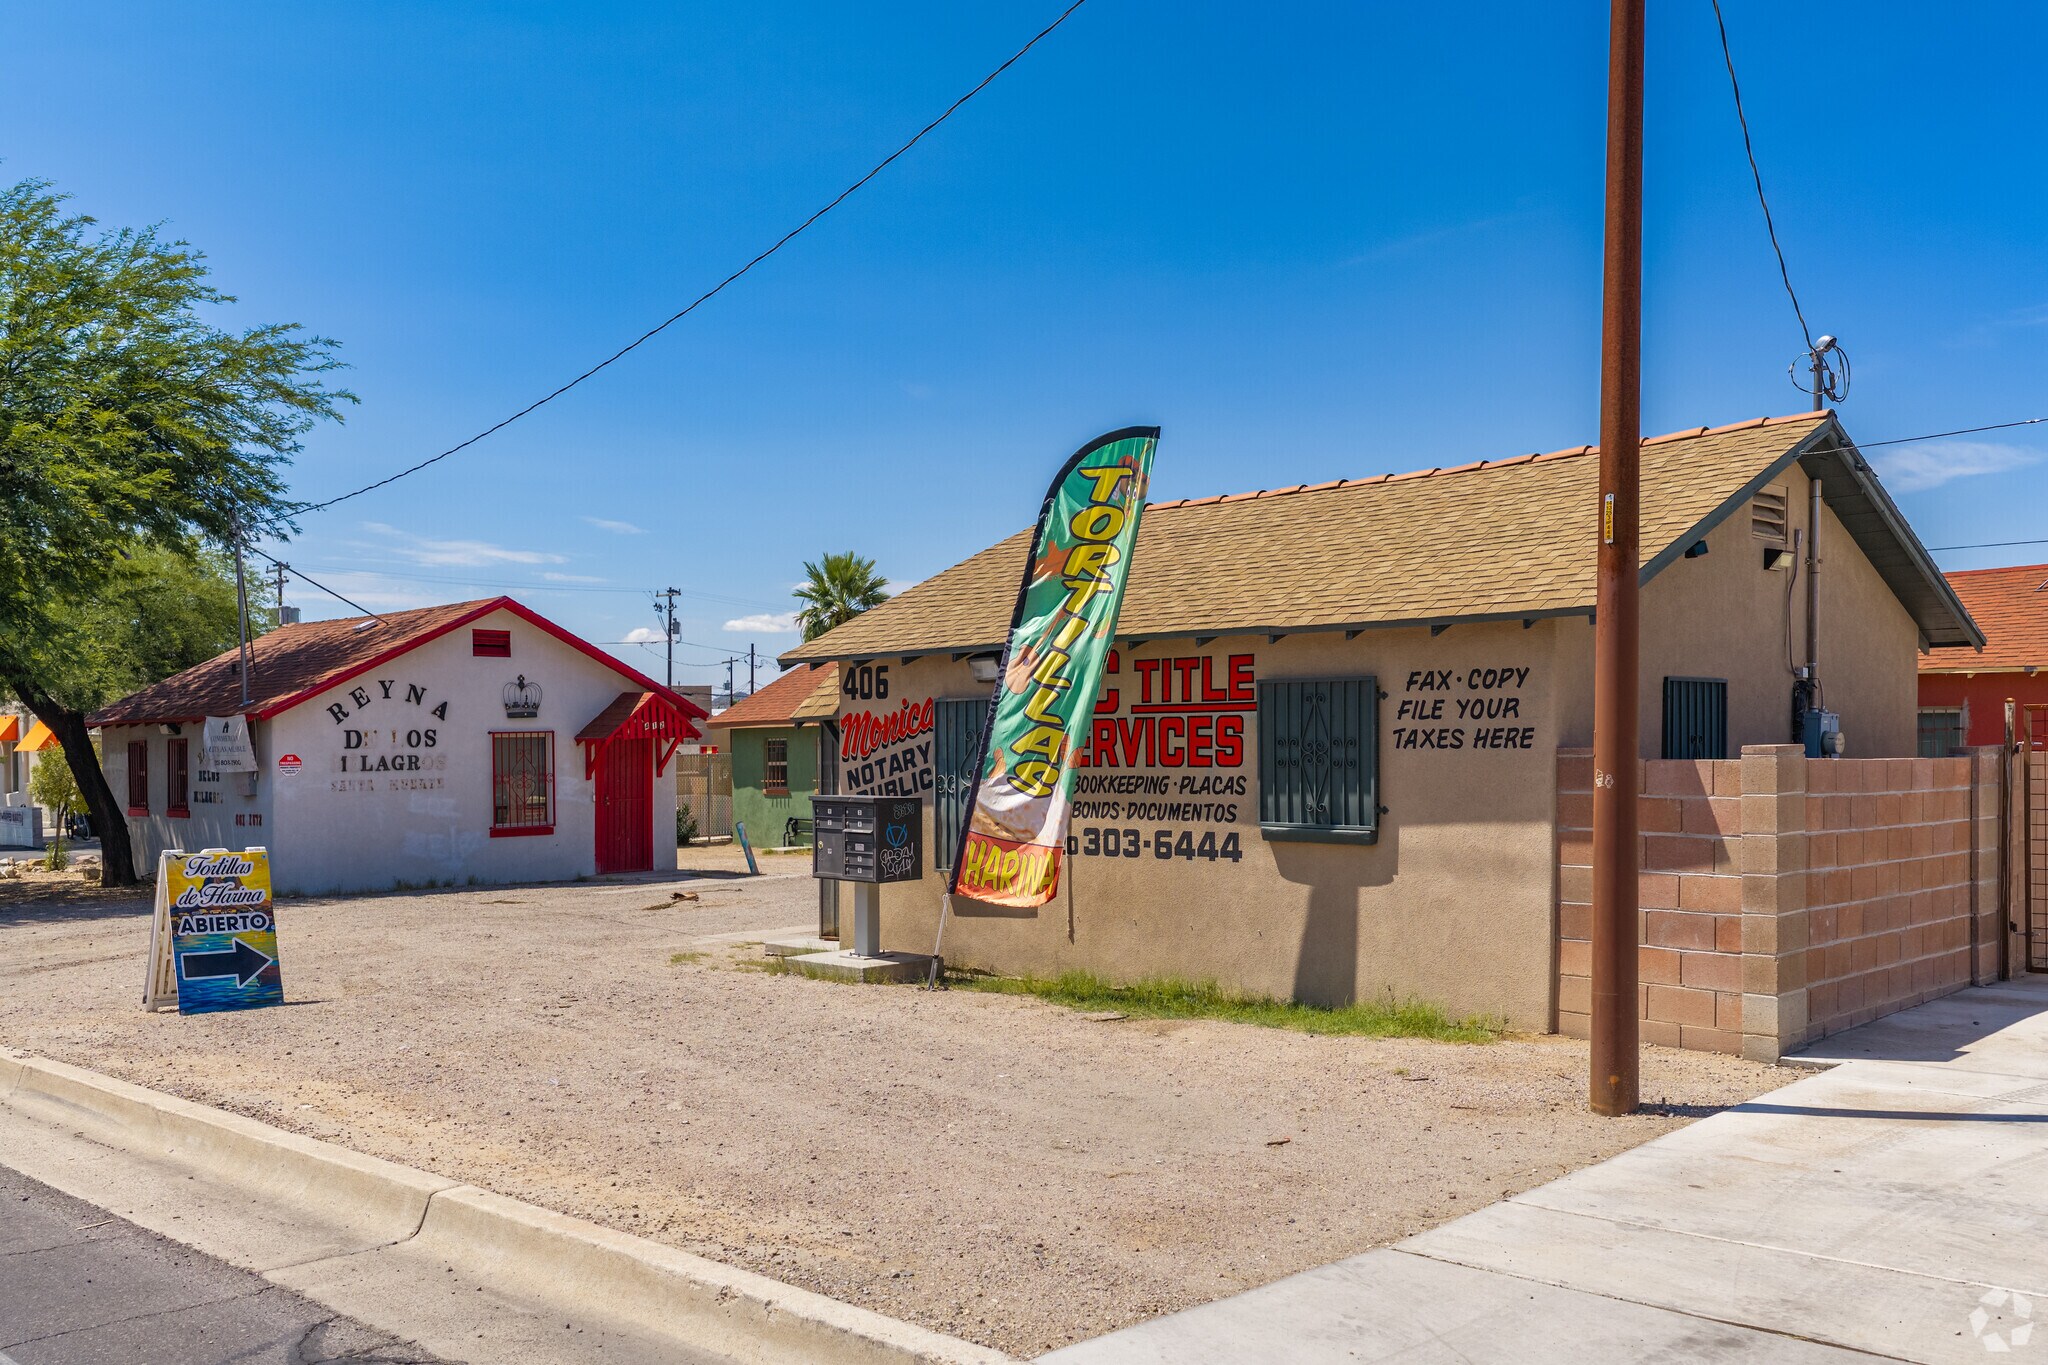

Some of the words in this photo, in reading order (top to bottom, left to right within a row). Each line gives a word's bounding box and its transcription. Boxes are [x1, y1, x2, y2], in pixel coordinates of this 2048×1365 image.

[1008, 466, 1132, 798] TORTILLAS
[843, 665, 889, 700] 406
[1134, 653, 1255, 703] TITLE
[326, 680, 448, 725] REYNA
[1397, 699, 1446, 720] FILE
[1456, 698, 1520, 719] YOUR
[841, 697, 934, 761] Monica
[1080, 715, 1244, 768] RVICES
[1393, 728, 1465, 749] TAXES
[1473, 727, 1535, 749] HERE
[847, 741, 931, 790] NOTARY
[856, 767, 934, 797] UBLIC
[1179, 776, 1247, 795] PLACAS
[185, 855, 252, 877] Tortillas
[964, 840, 1055, 899] HARINA
[178, 886, 199, 905] de
[200, 883, 265, 904] Harina
[180, 913, 268, 933] ABIERTO
